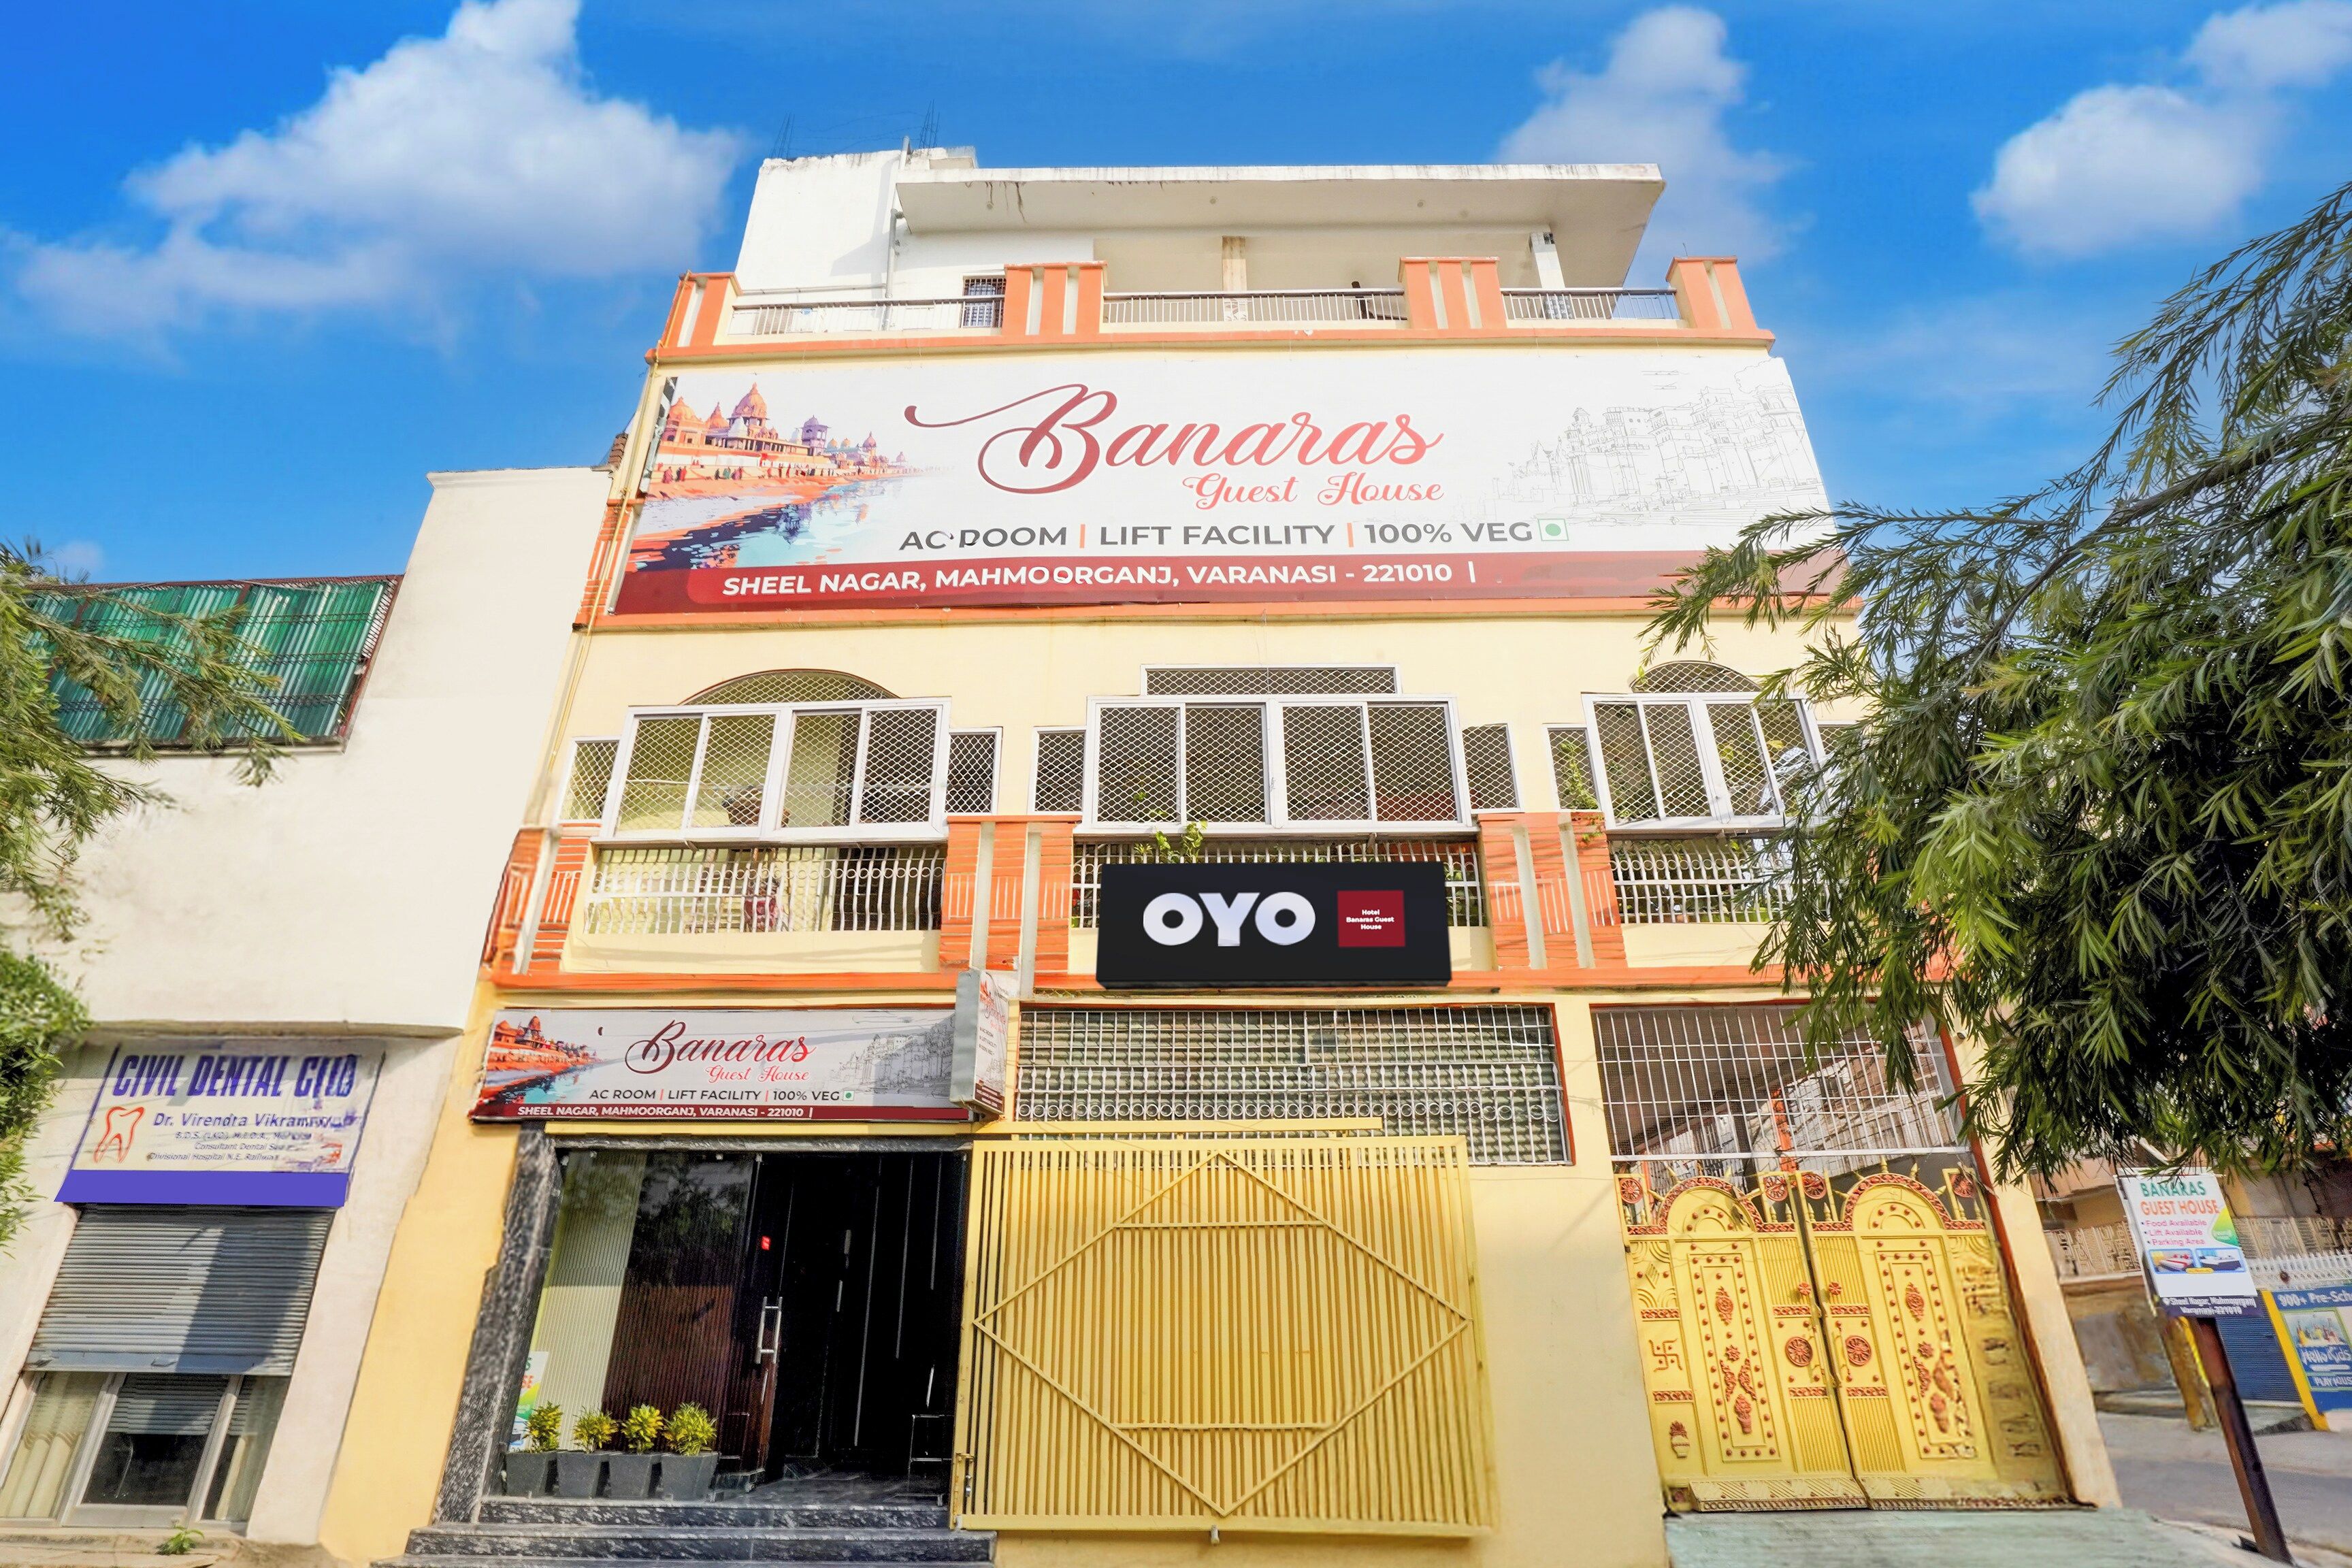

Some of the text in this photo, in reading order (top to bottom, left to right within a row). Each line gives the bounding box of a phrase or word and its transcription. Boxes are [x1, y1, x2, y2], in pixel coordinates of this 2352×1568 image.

[904, 383, 1444, 494] Banaras
[1182, 471, 1444, 510] Guest House
[899, 521, 1533, 551] AC ROOM LIFT FACILITY 100% VEG
[722, 568, 812, 596] SHEEL
[819, 570, 926, 593] NAGAR,
[935, 566, 1179, 589] MAHMOORGANJ,
[1186, 564, 1337, 584] VARANASI
[1362, 564, 1452, 583] 221010
[1143, 892, 1316, 947] OYO
[625, 1019, 816, 1074] Banaras
[112, 1055, 184, 1097] CIVIL
[187, 1055, 291, 1097] DENTAL
[705, 1064, 810, 1083] Guest House
[589, 1090, 840, 1100] AC ROOM LIFT FACILITY 100% VEG
[153, 1113, 174, 1126] Dr.
[517, 1106, 554, 1115] SHEEL
[555, 1106, 599, 1117] NAGAR,
[601, 1106, 697, 1117] MAHMOORGANJ,
[699, 1107, 757, 1117] VARANASI
[767, 1107, 804, 1117] 221010
[2140, 1181, 2206, 1197] BANARAS
[2140, 1198, 2221, 1216] GUEST HOUSE
[2152, 1239, 2184, 1247] Parking
